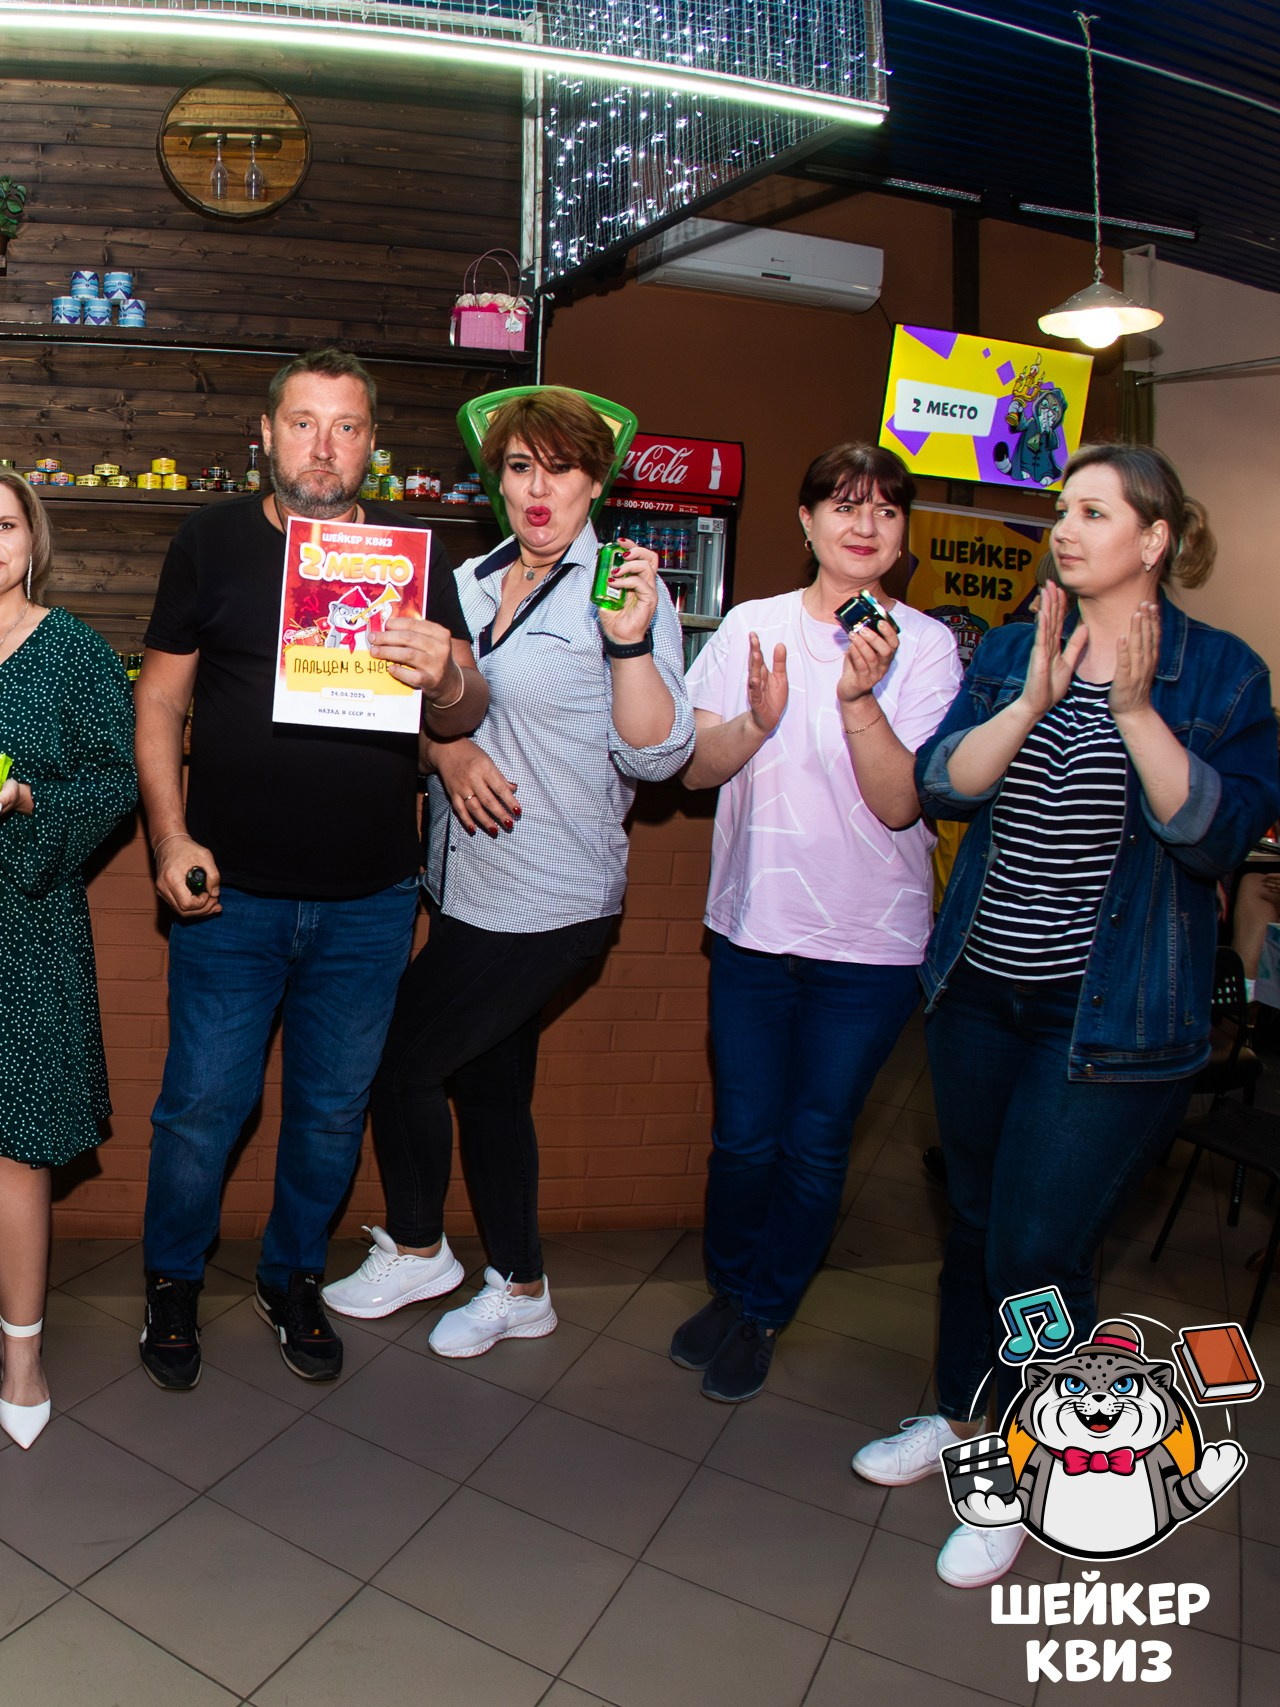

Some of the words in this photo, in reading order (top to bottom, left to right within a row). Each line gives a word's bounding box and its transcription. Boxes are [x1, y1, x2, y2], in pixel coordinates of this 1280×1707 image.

[912, 398, 921, 413] 2
[926, 400, 978, 420] МЕСТО
[616, 499, 674, 512] 8-800-700-7777
[322, 532, 362, 545] ШЕЙКЕР
[365, 536, 393, 547] КВИЗ
[301, 544, 324, 578] 2
[323, 553, 412, 584] МЕСТО
[930, 536, 1032, 572] ШЕЙКЕР
[945, 572, 1013, 601] КВИЗ
